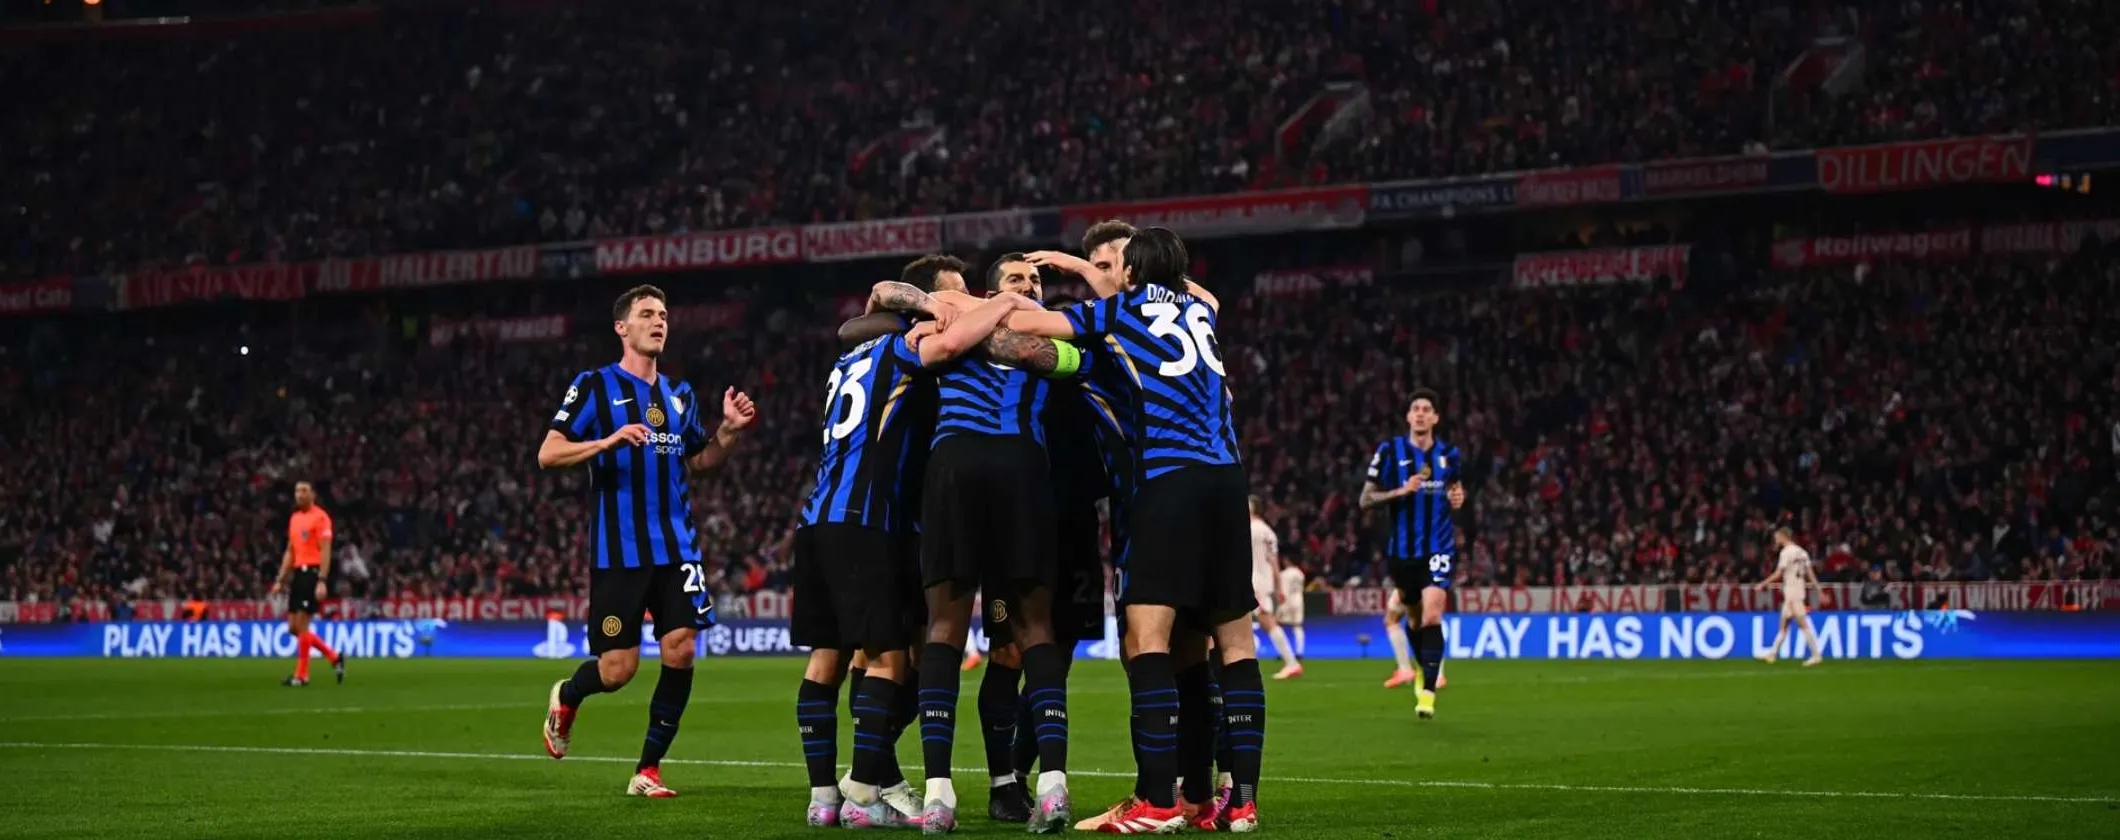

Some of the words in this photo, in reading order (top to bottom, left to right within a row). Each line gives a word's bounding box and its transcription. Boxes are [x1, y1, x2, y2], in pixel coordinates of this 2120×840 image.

[1817, 137, 2031, 190] DILLINGEN
[596, 229, 798, 272] MAINBURG
[1141, 302, 1227, 377] 36
[1461, 587, 1532, 612] BAD
[103, 623, 173, 657] PLAY
[181, 623, 242, 657] HAS
[251, 623, 299, 657] NO
[309, 621, 414, 657] LIMITS
[734, 627, 792, 652] UEFA
[1547, 616, 1644, 658] HAS
[1659, 615, 1735, 659] NO
[1752, 611, 1924, 660] LIMITS
[925, 705, 949, 719] INTER
